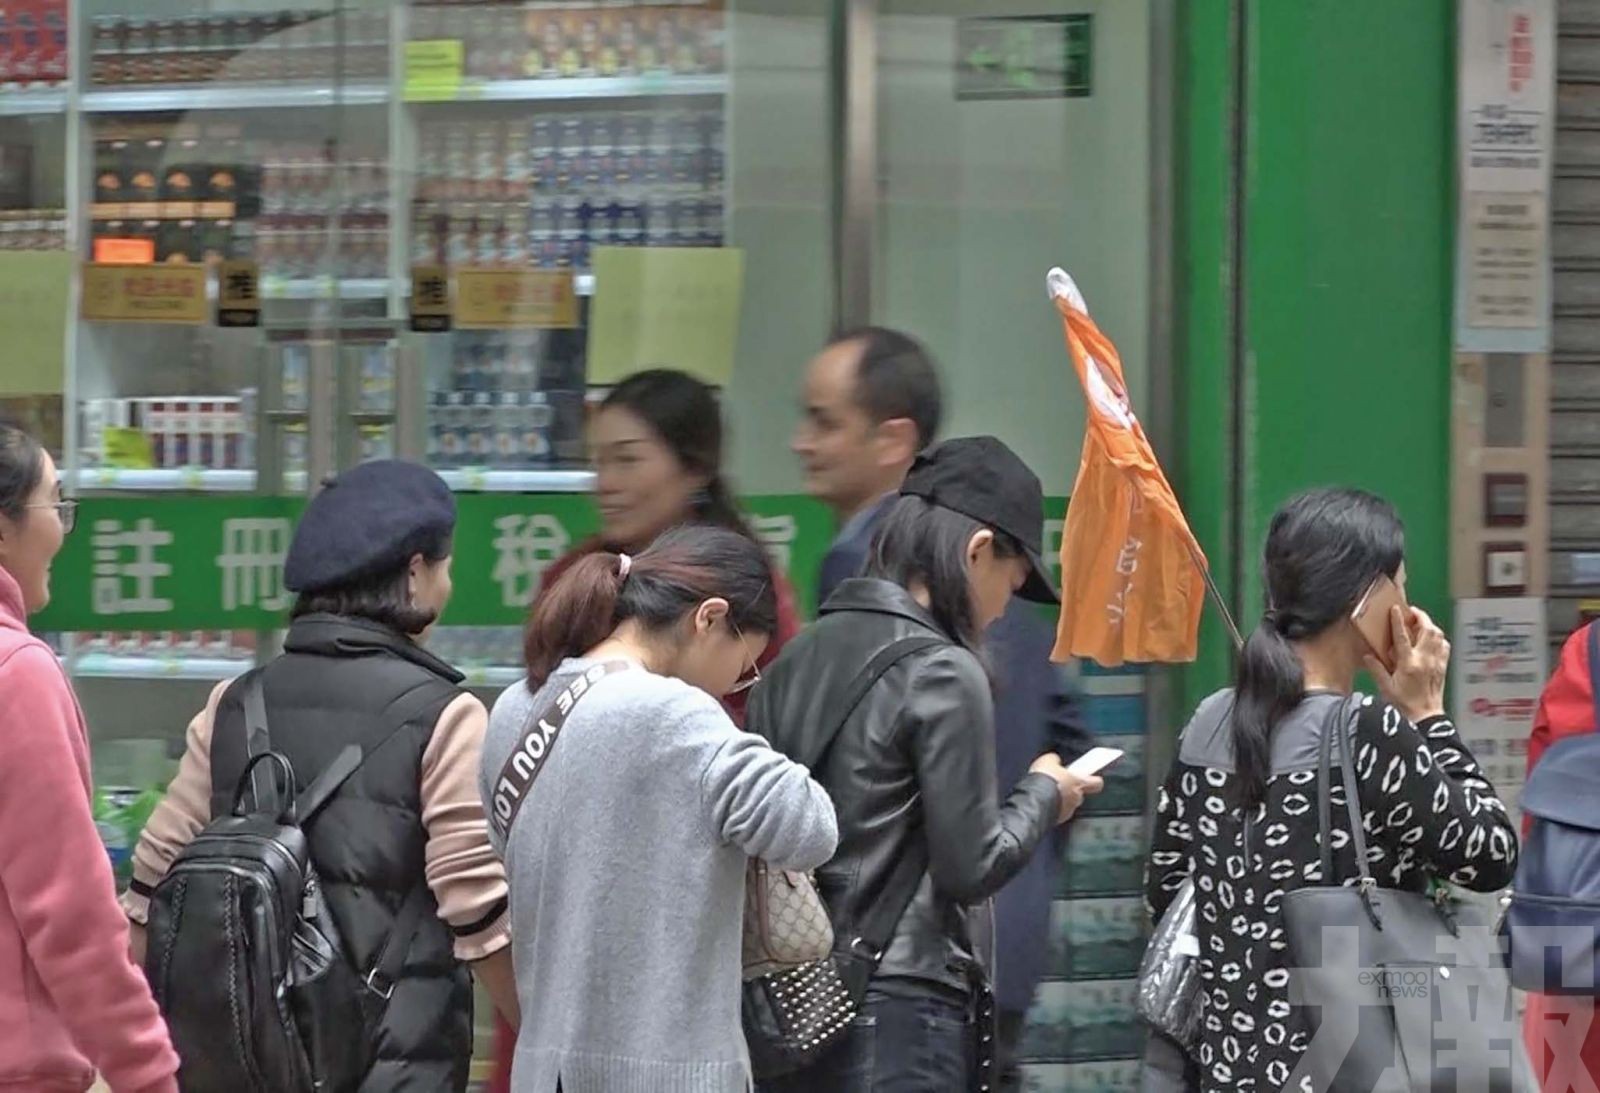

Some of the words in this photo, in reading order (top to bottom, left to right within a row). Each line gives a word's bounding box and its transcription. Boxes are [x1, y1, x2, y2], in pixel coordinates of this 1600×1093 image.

[556, 664, 606, 715] SEE
[511, 718, 556, 781] YOU
[494, 776, 520, 836] LOV
